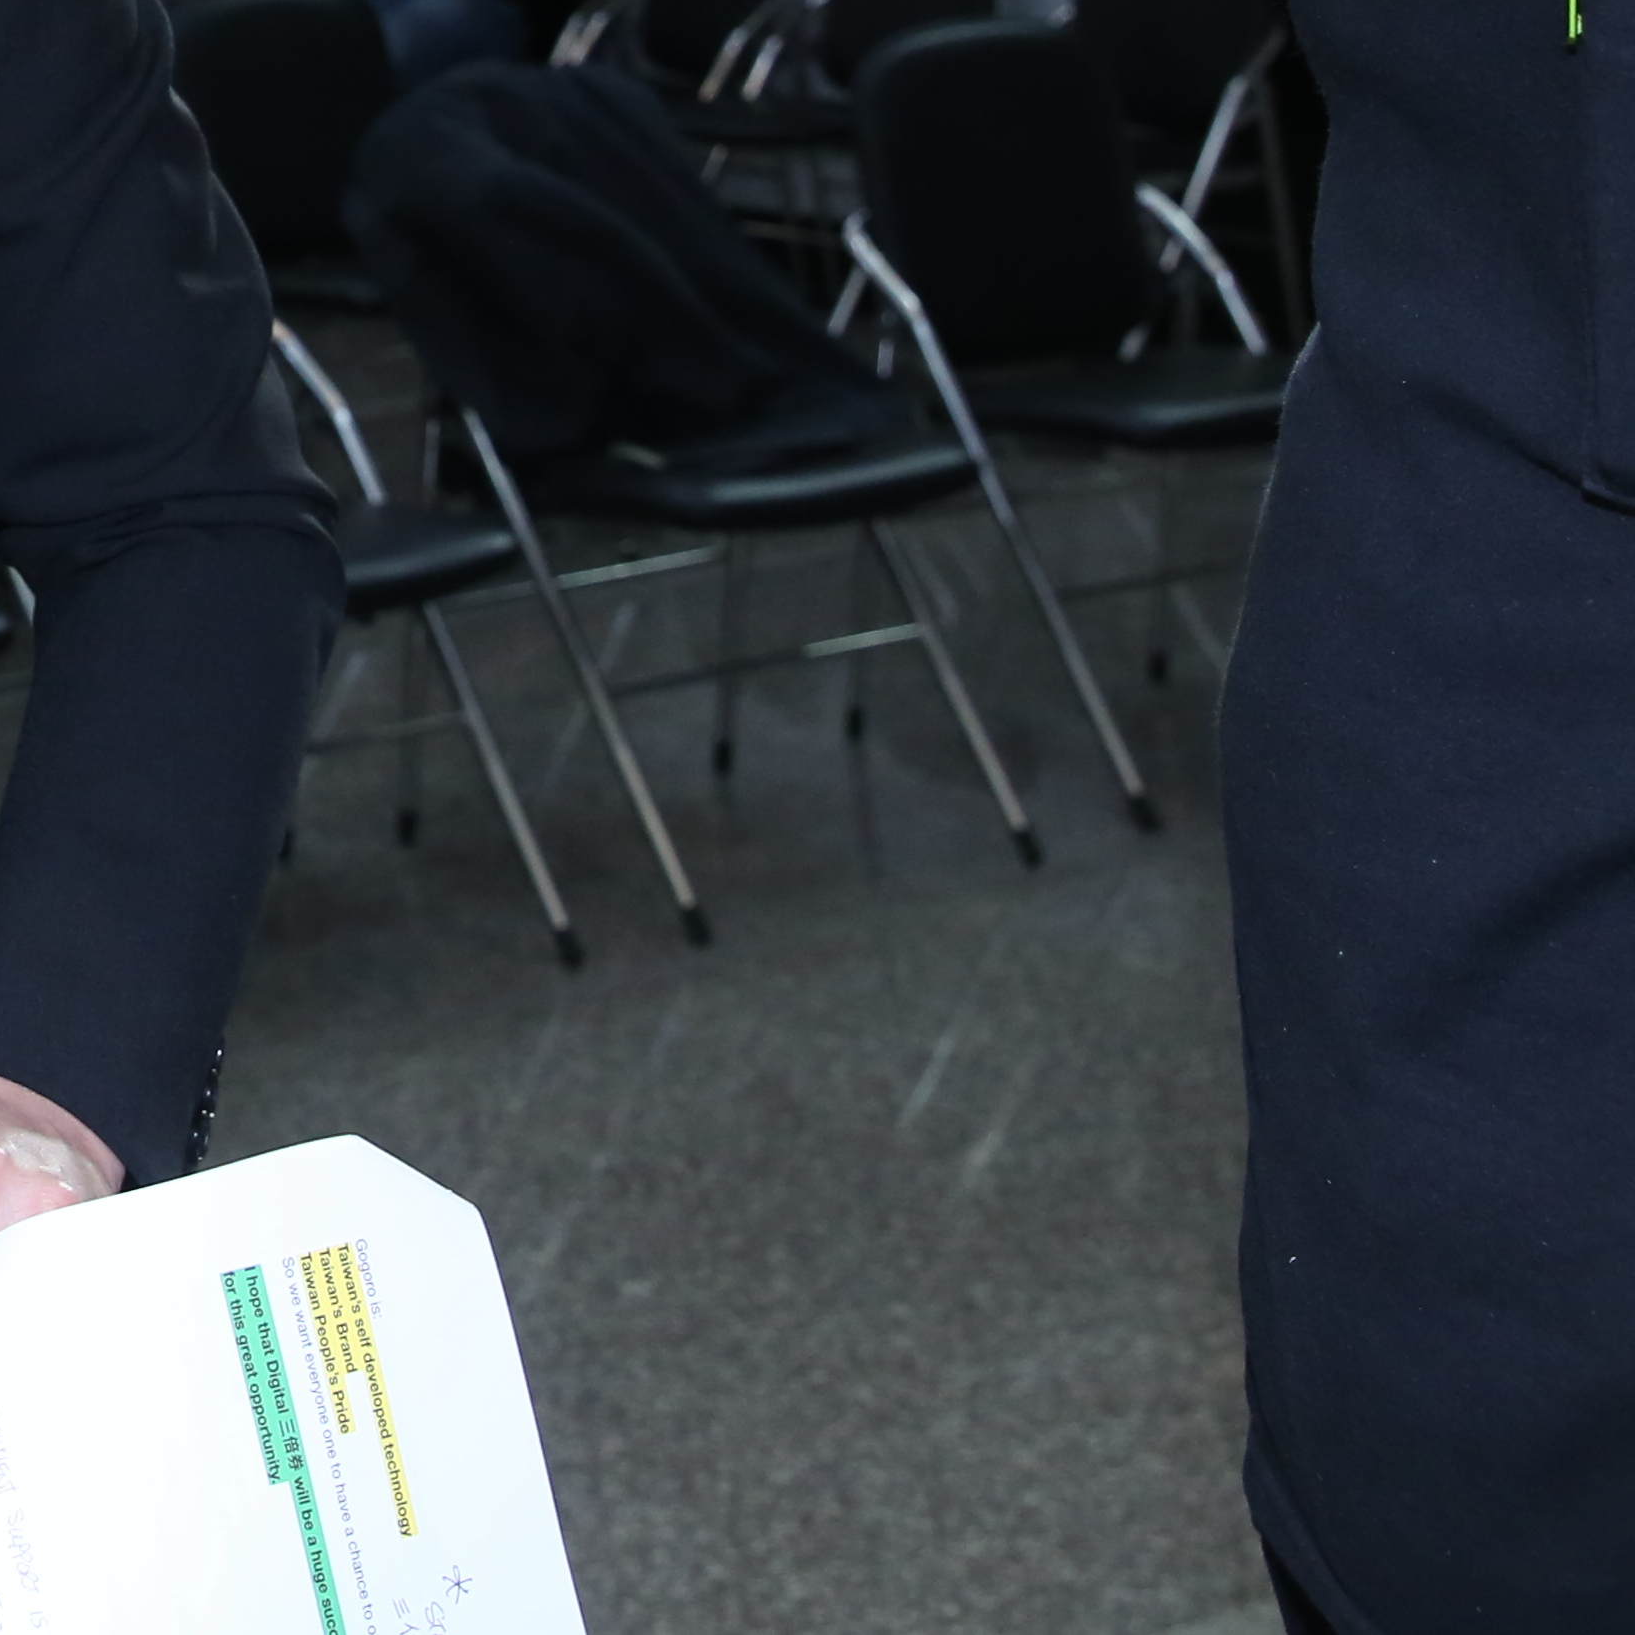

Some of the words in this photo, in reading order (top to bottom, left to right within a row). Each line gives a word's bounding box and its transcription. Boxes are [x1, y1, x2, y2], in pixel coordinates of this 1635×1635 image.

[222, 1271, 238, 1295] for
[282, 1256, 295, 1279] So
[337, 1243, 362, 1314] Taiwan's
[355, 1238, 377, 1298] Gogoro
[370, 1301, 382, 1319] is:
[245, 1274, 264, 1318] hope
[288, 1283, 301, 1306] we
[319, 1248, 343, 1319] Taiwan's
[335, 1322, 358, 1374] Brand
[229, 1298, 246, 1331] this
[295, 1310, 313, 1348] want
[354, 1318, 373, 1348] self
[235, 1334, 259, 1380] great
[257, 1321, 275, 1357] that
[300, 1252, 321, 1311] Taiwan
[314, 1314, 340, 1386] People's
[332, 1389, 351, 1434] Pride
[266, 1359, 290, 1415] Digital
[304, 1353, 329, 1425] everyone
[362, 1352, 393, 1440] developed
[249, 1382, 281, 1485] opportunity.
[278, 1418, 305, 1472] 三倍券
[322, 1429, 337, 1459] one
[293, 1475, 312, 1506] will
[330, 1462, 342, 1480] to
[383, 1442, 413, 1537] technology
[300, 1508, 314, 1531] be
[335, 1483, 351, 1522] have
[307, 1536, 317, 1547] a
[344, 1527, 355, 1537] a
[310, 1549, 328, 1594] huge
[348, 1541, 369, 1600] chance
[362, 1603, 373, 1621] to
